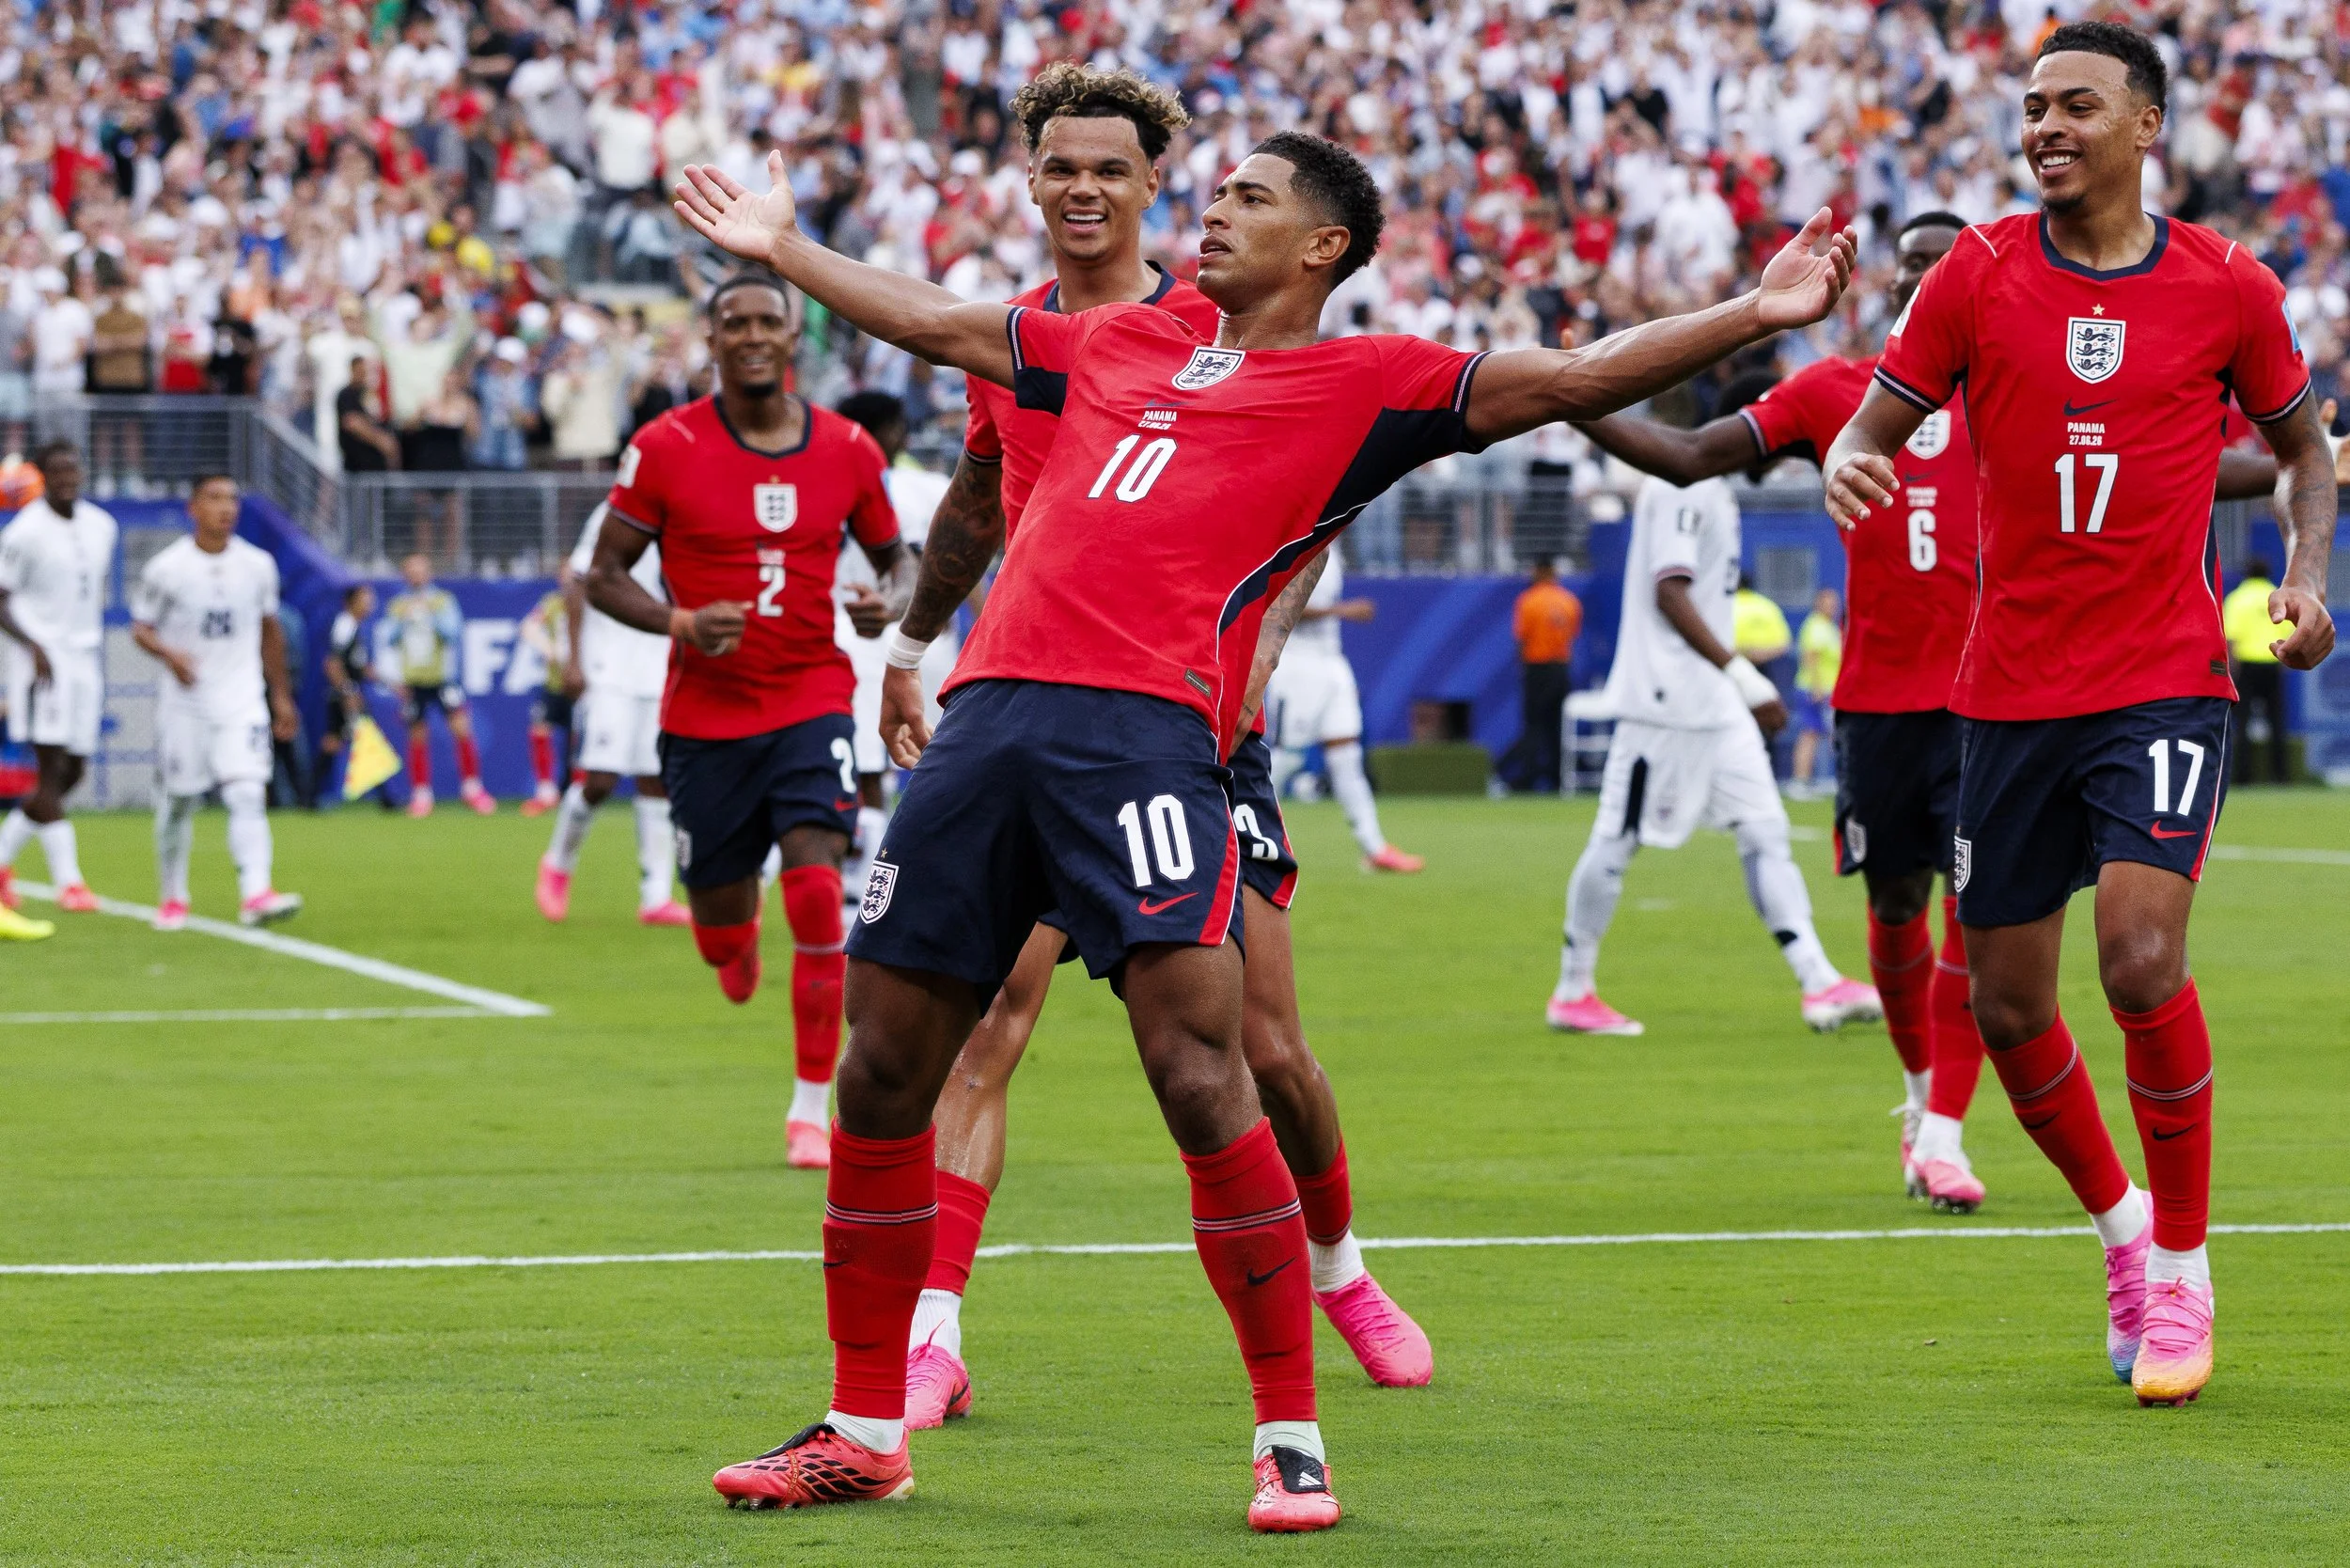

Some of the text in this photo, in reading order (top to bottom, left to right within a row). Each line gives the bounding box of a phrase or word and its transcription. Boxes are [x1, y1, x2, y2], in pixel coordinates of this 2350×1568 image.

[1142, 410, 1178, 422] PANAMA
[2067, 421, 2106, 434] PANAMA
[1087, 433, 1179, 503] 10
[2054, 453, 2120, 534] 17
[1907, 508, 1937, 572] 6
[757, 564, 787, 618] 2
[2148, 738, 2205, 817] 17
[1116, 792, 1197, 888] 10
